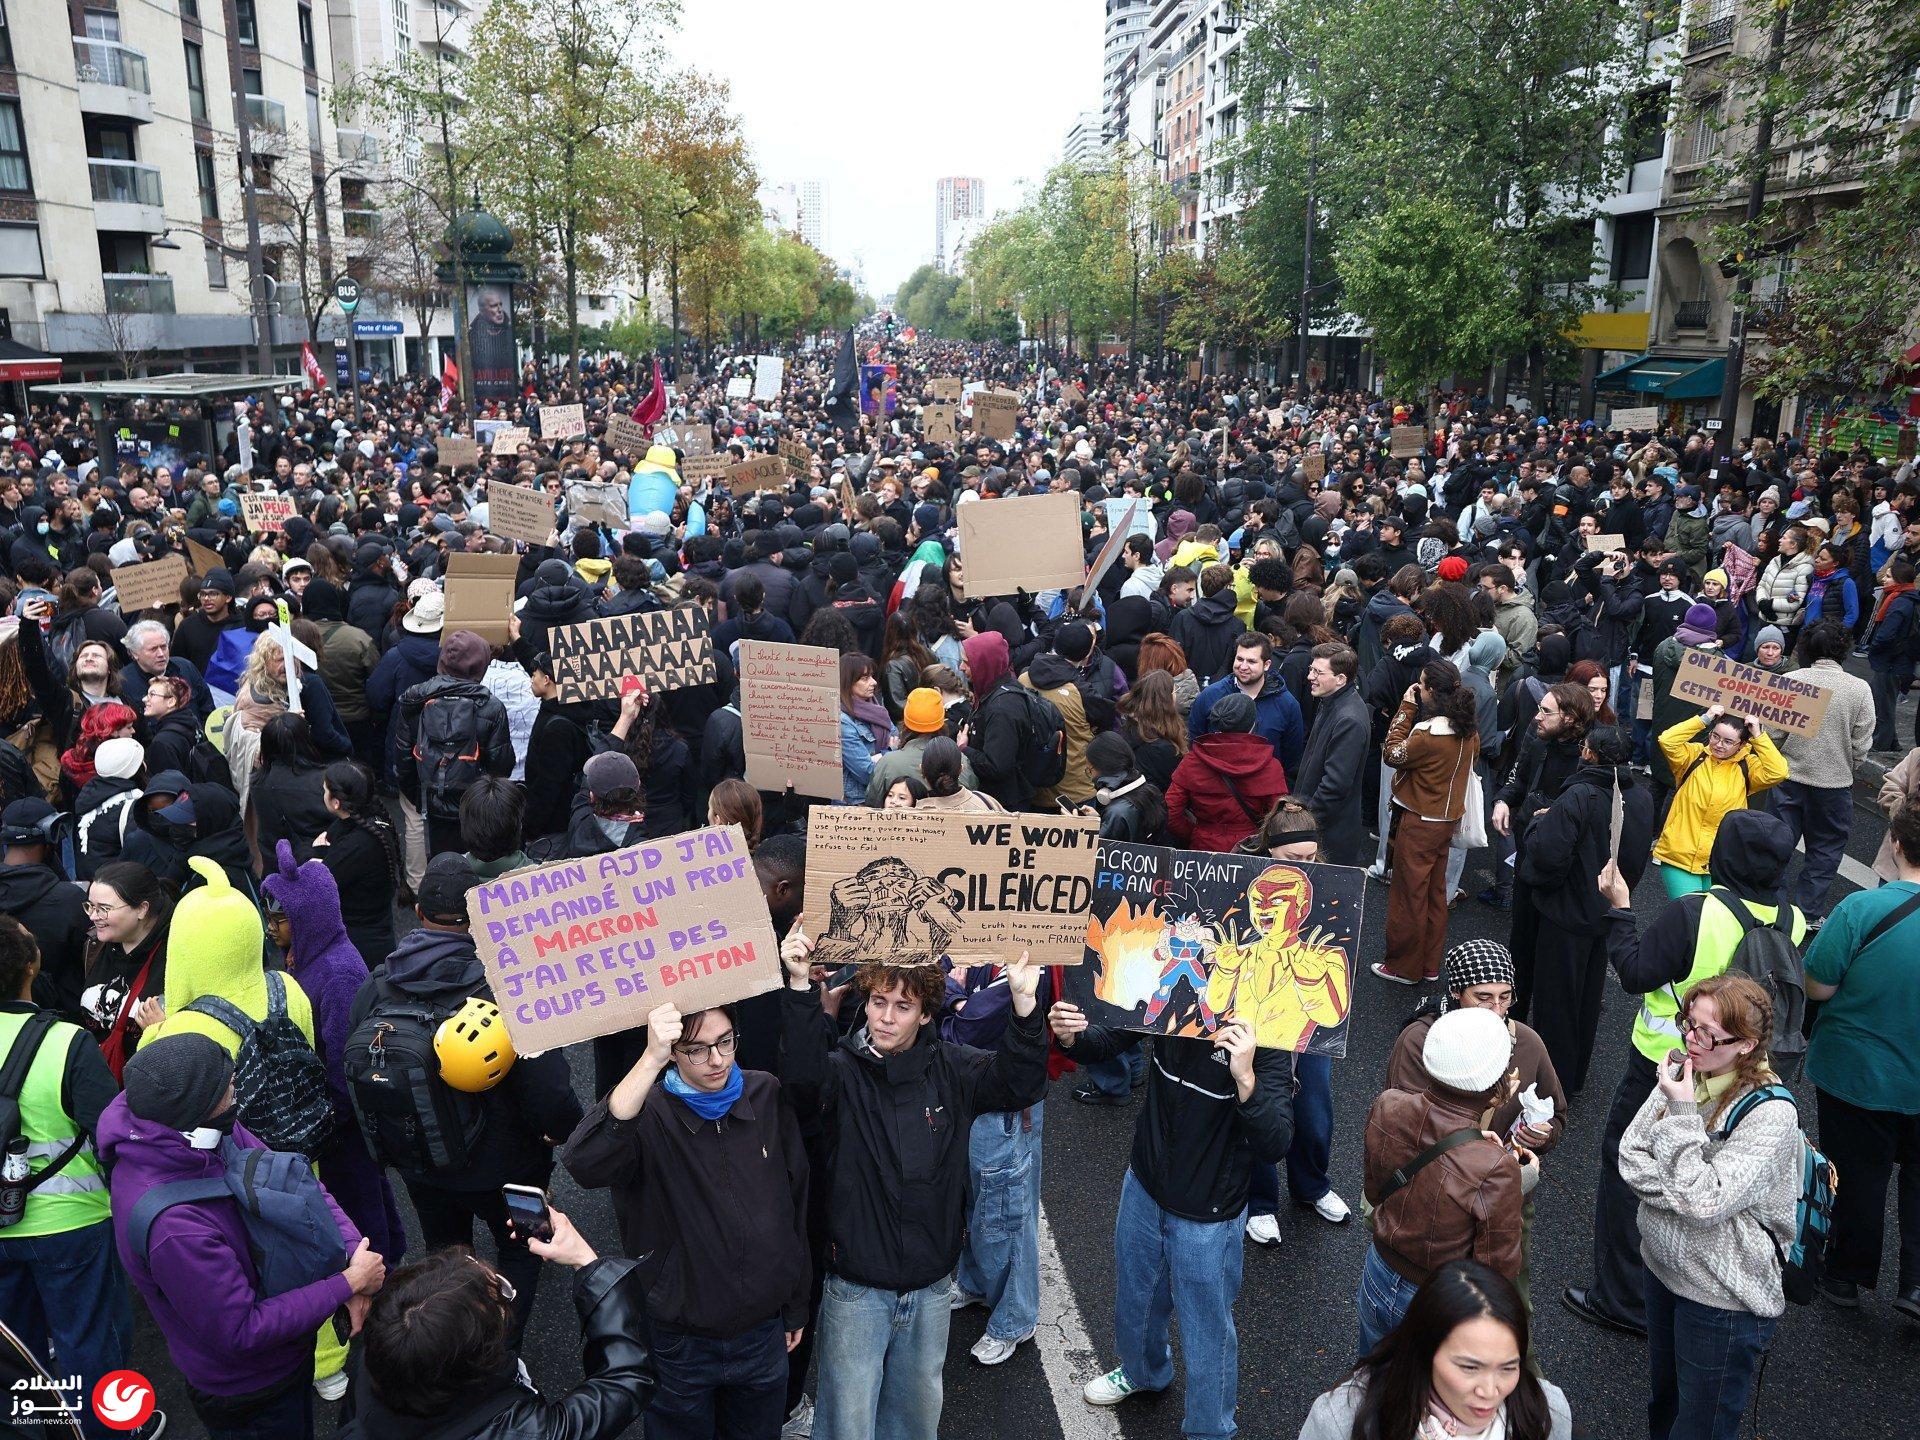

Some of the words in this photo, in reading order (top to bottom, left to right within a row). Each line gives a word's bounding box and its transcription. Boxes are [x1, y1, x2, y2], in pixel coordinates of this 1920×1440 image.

[338, 286, 356, 296] BUS
[541, 408, 551, 416] 18
[554, 406, 571, 414] ANS
[731, 462, 781, 488] ARNAQUE
[263, 502, 292, 515] PEUR
[786, 651, 795, 662] de
[798, 655, 837, 667] manifester
[747, 663, 780, 678] Quelles
[785, 672, 796, 682] que
[1731, 663, 1762, 684] PAS
[1768, 674, 1821, 699] ENCORE
[748, 680, 756, 689] les
[761, 683, 814, 693] circonstances,
[1717, 677, 1797, 709] CONFISQUÉ
[748, 690, 773, 703] chaque
[777, 693, 803, 704] citoyen
[807, 696, 823, 704] doit
[1679, 680, 1722, 703] CETTE
[1730, 695, 1810, 729] PANCARTE
[748, 703, 775, 712] pouvoir
[779, 704, 812, 714] exprimer
[750, 713, 786, 721] convictions
[793, 725, 810, 734] toute
[787, 744, 817, 756] Macron
[817, 812, 839, 825] They
[867, 812, 907, 821] TRUTH
[927, 815, 945, 824] they
[834, 824, 876, 834] pressure,
[878, 826, 902, 834] power
[922, 828, 946, 836] money
[965, 823, 1011, 846] WE
[1021, 825, 1099, 850] WON'T
[910, 835, 928, 844] that
[1008, 848, 1036, 869] BE
[1095, 847, 1157, 874] ACRON
[1174, 860, 1243, 883] DEVANT
[478, 865, 586, 915] MAMAN
[599, 848, 662, 879] AJD
[676, 830, 734, 863] J'AI
[937, 867, 1092, 914] SILENCED
[1097, 872, 1173, 897] FRANCE
[487, 883, 619, 943] DEMANDÉ
[633, 876, 676, 905] UN
[685, 857, 748, 891] PROF
[981, 922, 1005, 930] truth
[1012, 922, 1027, 930] has
[497, 942, 521, 970] À
[533, 907, 659, 958] MACRON
[962, 934, 992, 943] buried
[1012, 935, 1032, 946] long
[1048, 934, 1087, 944] FRANCE
[504, 963, 567, 998] J'AI
[576, 938, 656, 977] REÇU
[669, 919, 728, 951] DES
[516, 981, 606, 1025] COUPS
[615, 971, 648, 997] DE
[659, 942, 756, 988] BATON
